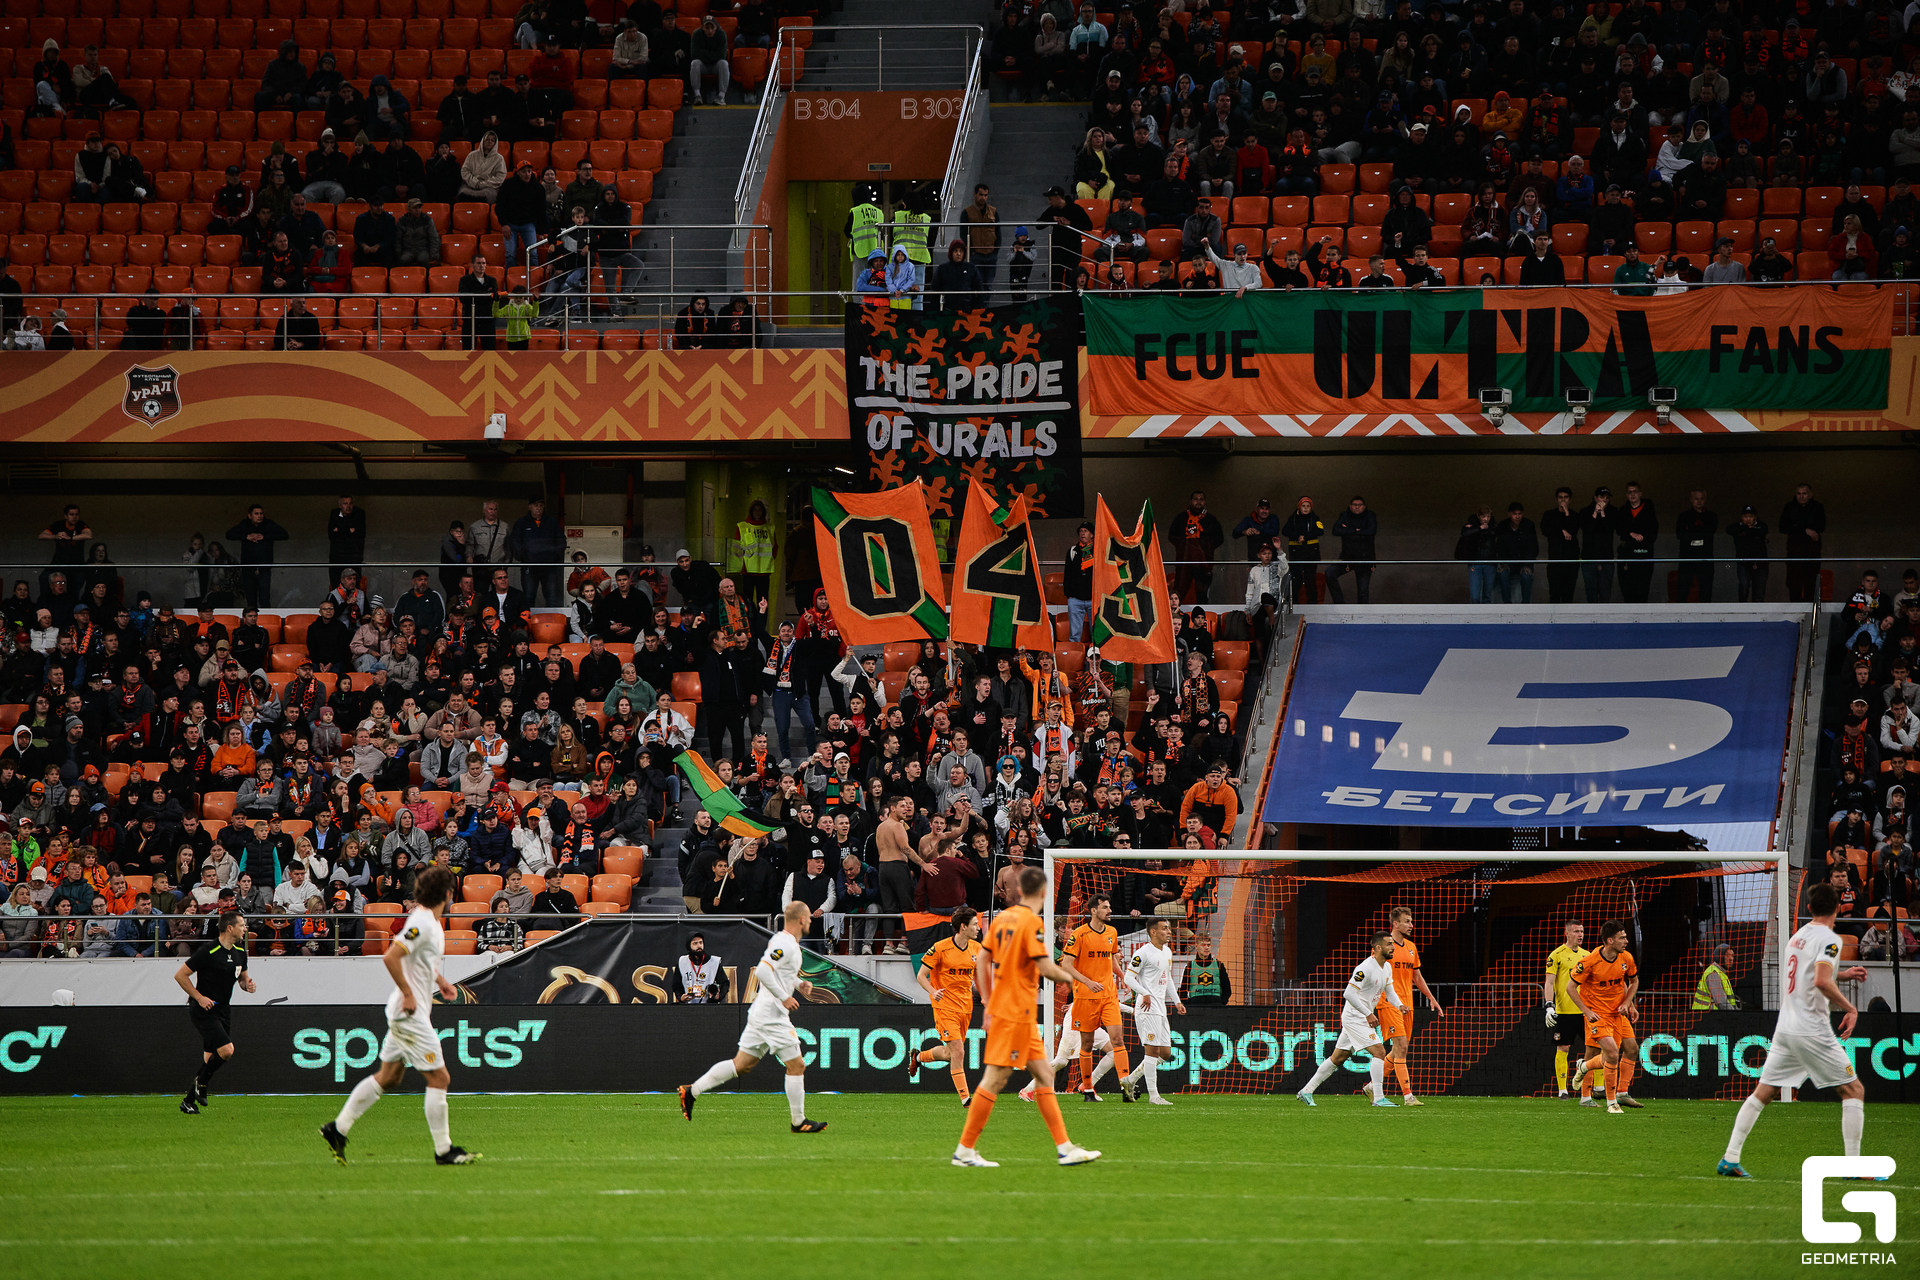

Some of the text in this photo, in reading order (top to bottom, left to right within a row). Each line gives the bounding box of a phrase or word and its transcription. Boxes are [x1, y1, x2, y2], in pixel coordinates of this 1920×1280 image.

[795, 98, 861, 120] B 304
[901, 97, 963, 120] B 303
[1134, 306, 1844, 399] FCUE ULTRA FANS
[132, 381, 172, 402] УРАЛ
[859, 356, 1063, 399] THE PRIDE
[867, 413, 1058, 458] OF URALS
[963, 519, 1042, 626] 4
[1098, 535, 1160, 641] 3
[1321, 783, 1726, 816] БЕТСИТИ
[1787, 954, 1798, 995] 3
